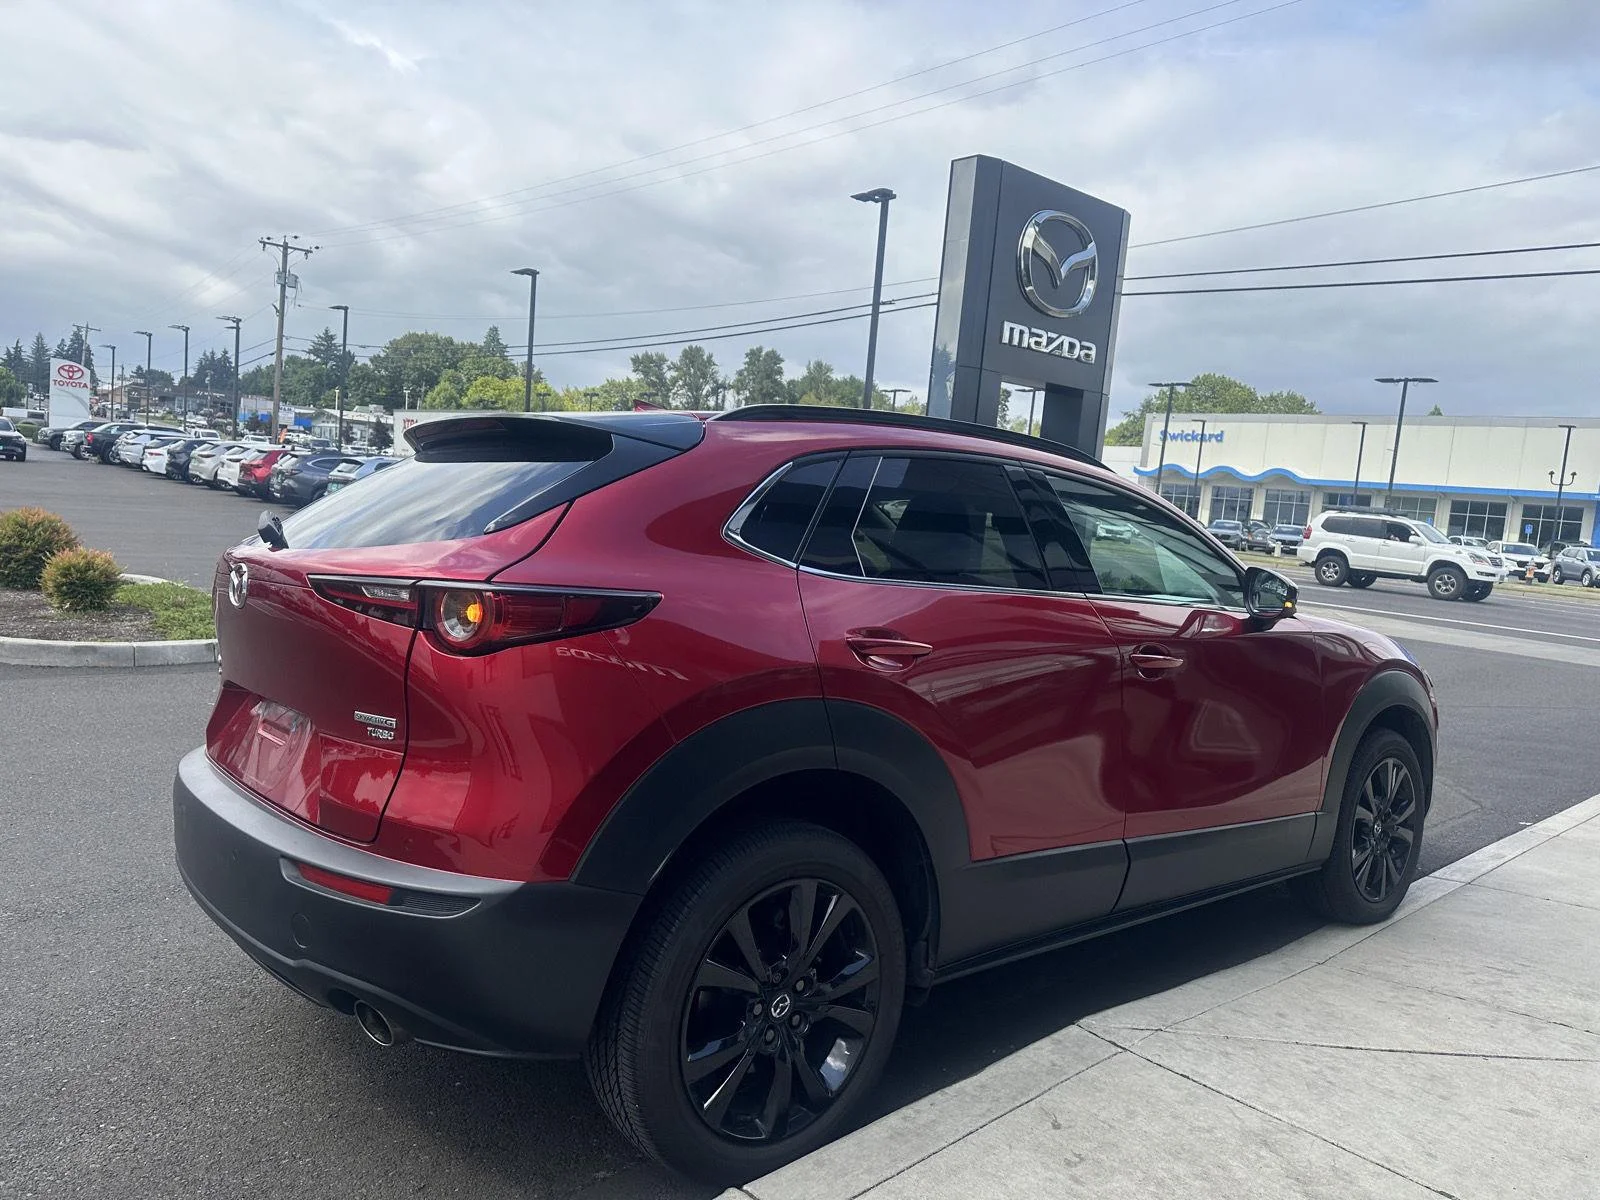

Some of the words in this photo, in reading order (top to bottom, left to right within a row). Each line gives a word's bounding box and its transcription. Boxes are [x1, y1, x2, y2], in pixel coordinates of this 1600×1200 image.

[52, 379, 89, 389] TOYOTA
[1159, 429, 1224, 442] Swickard
[366, 727, 394, 740] TURBO
